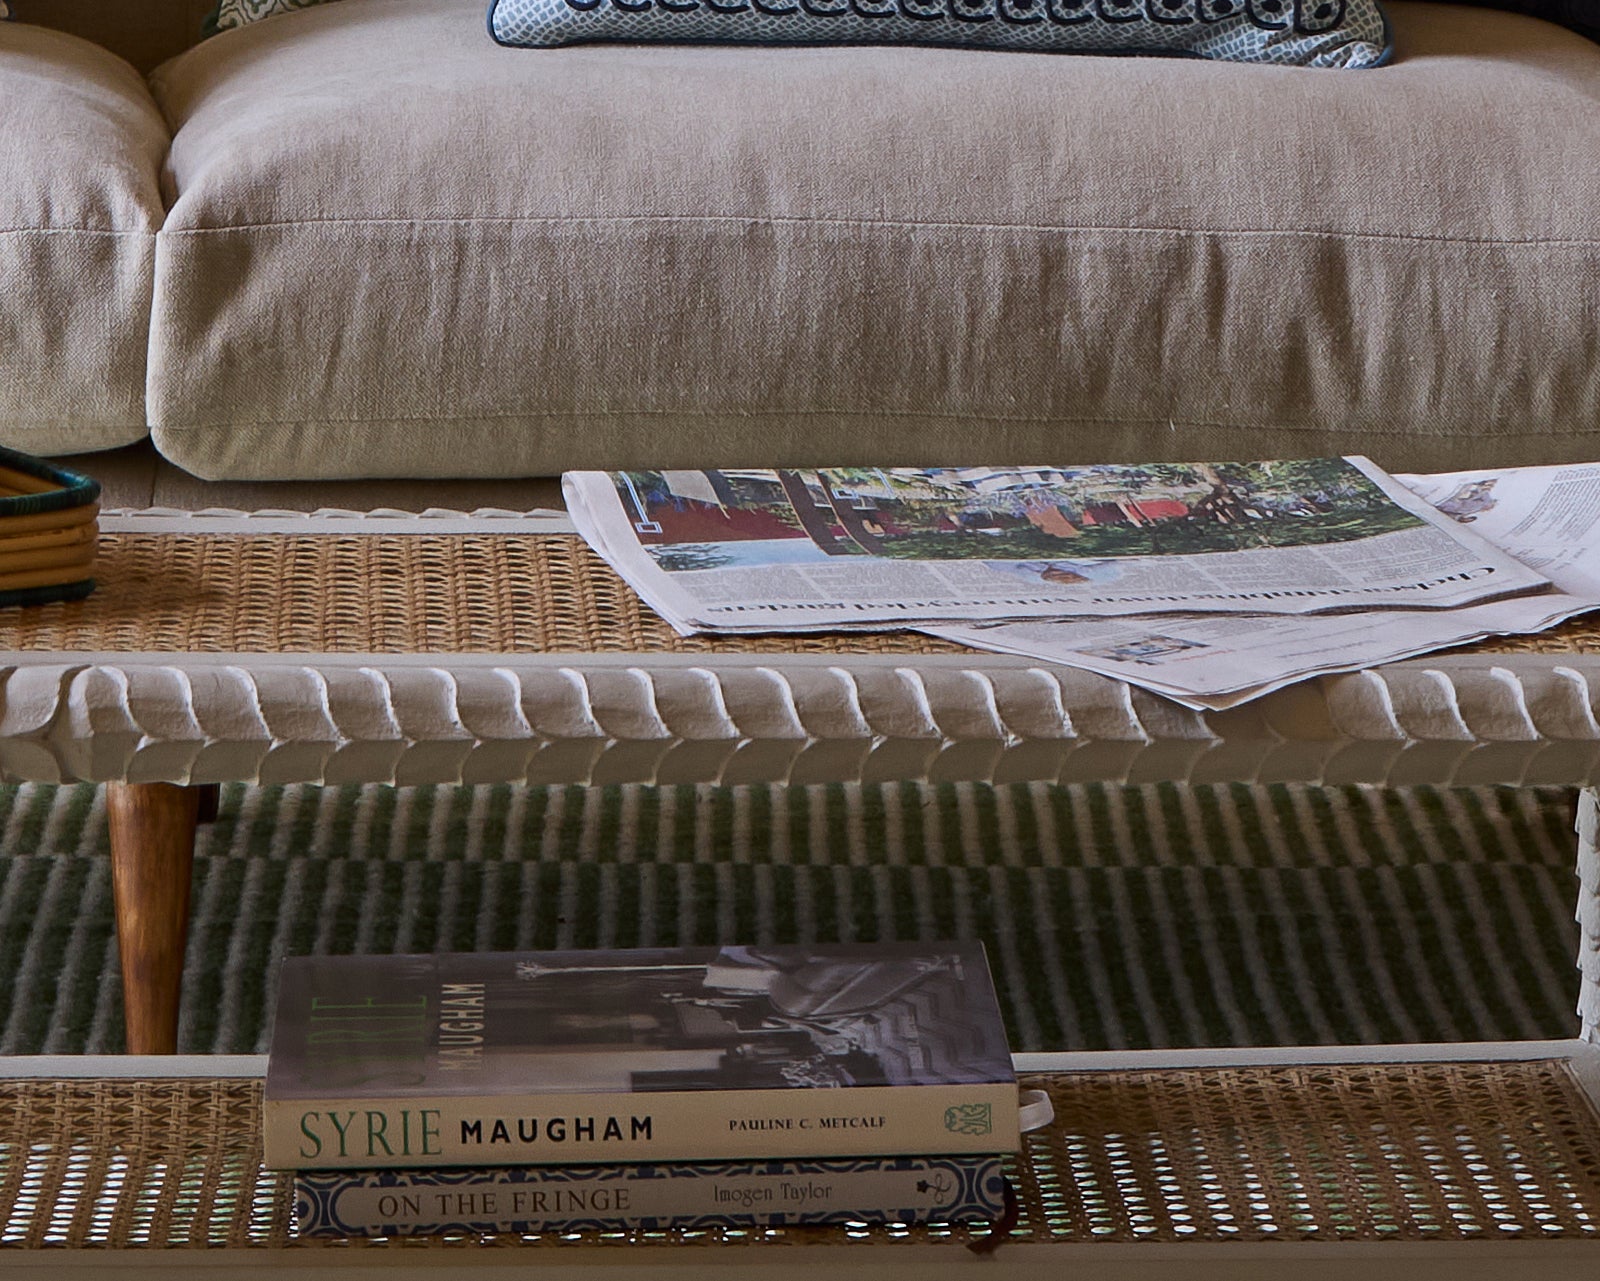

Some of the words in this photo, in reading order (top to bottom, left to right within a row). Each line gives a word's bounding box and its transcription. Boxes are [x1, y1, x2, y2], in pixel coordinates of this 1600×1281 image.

[1362, 566, 1496, 593] Chelsea
[706, 601, 847, 612] gardens
[1005, 597, 1081, 605] with
[437, 983, 485, 1070] MAUGHAM
[300, 1109, 442, 1159] SYRIE
[461, 1116, 653, 1145] MAUGHAM
[729, 1118, 793, 1131] PAULINE
[819, 1116, 886, 1130] METCALF
[378, 1194, 422, 1217] ON
[435, 1192, 498, 1215] THE
[512, 1188, 631, 1213] FRINGE
[714, 1184, 773, 1207] Imogen
[780, 1180, 833, 1205] Taylor
